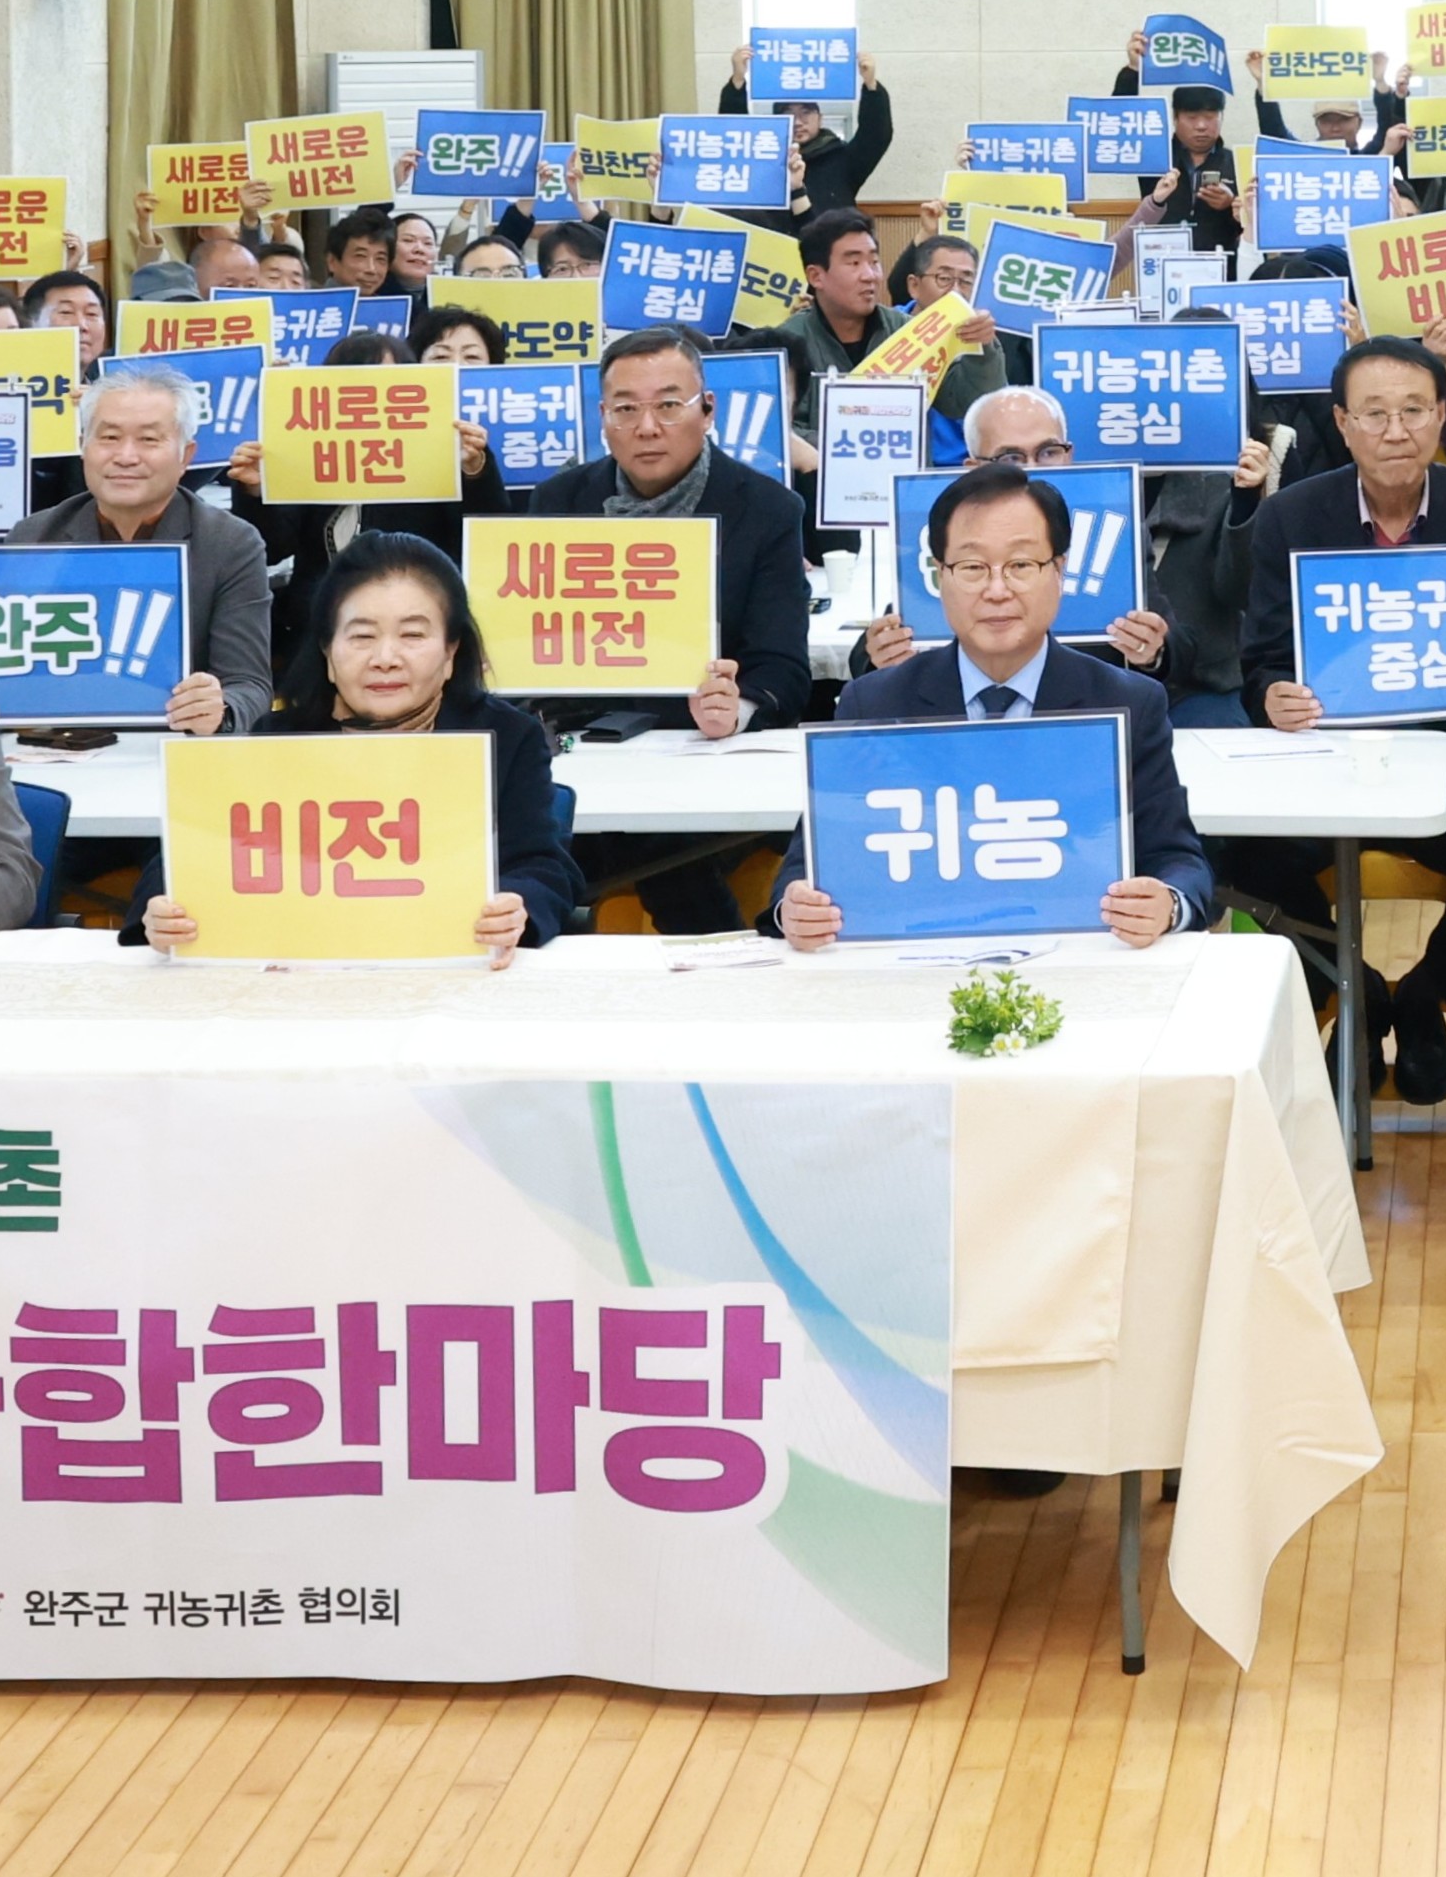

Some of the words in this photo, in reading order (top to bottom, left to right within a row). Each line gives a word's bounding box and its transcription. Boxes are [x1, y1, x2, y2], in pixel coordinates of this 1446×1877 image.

[756, 38, 851, 66] 귀농귀촌
[1150, 31, 1226, 78] 완주!!
[1267, 50, 1368, 78] 힘찬도약
[779, 66, 826, 91] 중심
[1075, 109, 1164, 137] 귀농귀촌
[266, 124, 370, 166] 새로운
[429, 134, 537, 178] 완주!!
[667, 128, 781, 160] 귀농귀촌
[973, 137, 1077, 164] 귀농귀촌
[1094, 139, 1143, 164] 중심
[288, 165, 357, 198] 비전
[695, 164, 751, 194] 중심
[1263, 170, 1382, 201] 귀농귀촌
[1293, 206, 1352, 238] 중심
[617, 240, 737, 285] 귀농귀촌
[643, 284, 706, 323] 중심
[1052, 346, 1228, 395] 귀농귀촌
[284, 383, 430, 433] 새로운
[1096, 401, 1182, 446] 중심
[313, 438, 407, 485] 비전
[501, 429, 576, 470] 중심
[830, 428, 914, 461] 소양면
[496, 541, 681, 603] 새로운
[532, 609, 649, 669] 비전
[229, 797, 425, 899] 비전
[864, 781, 1069, 884] 귀농
[22, 1588, 130, 1627] 완주군
[143, 1587, 286, 1628] 귀농귀촌
[297, 1585, 402, 1626] 협의회
